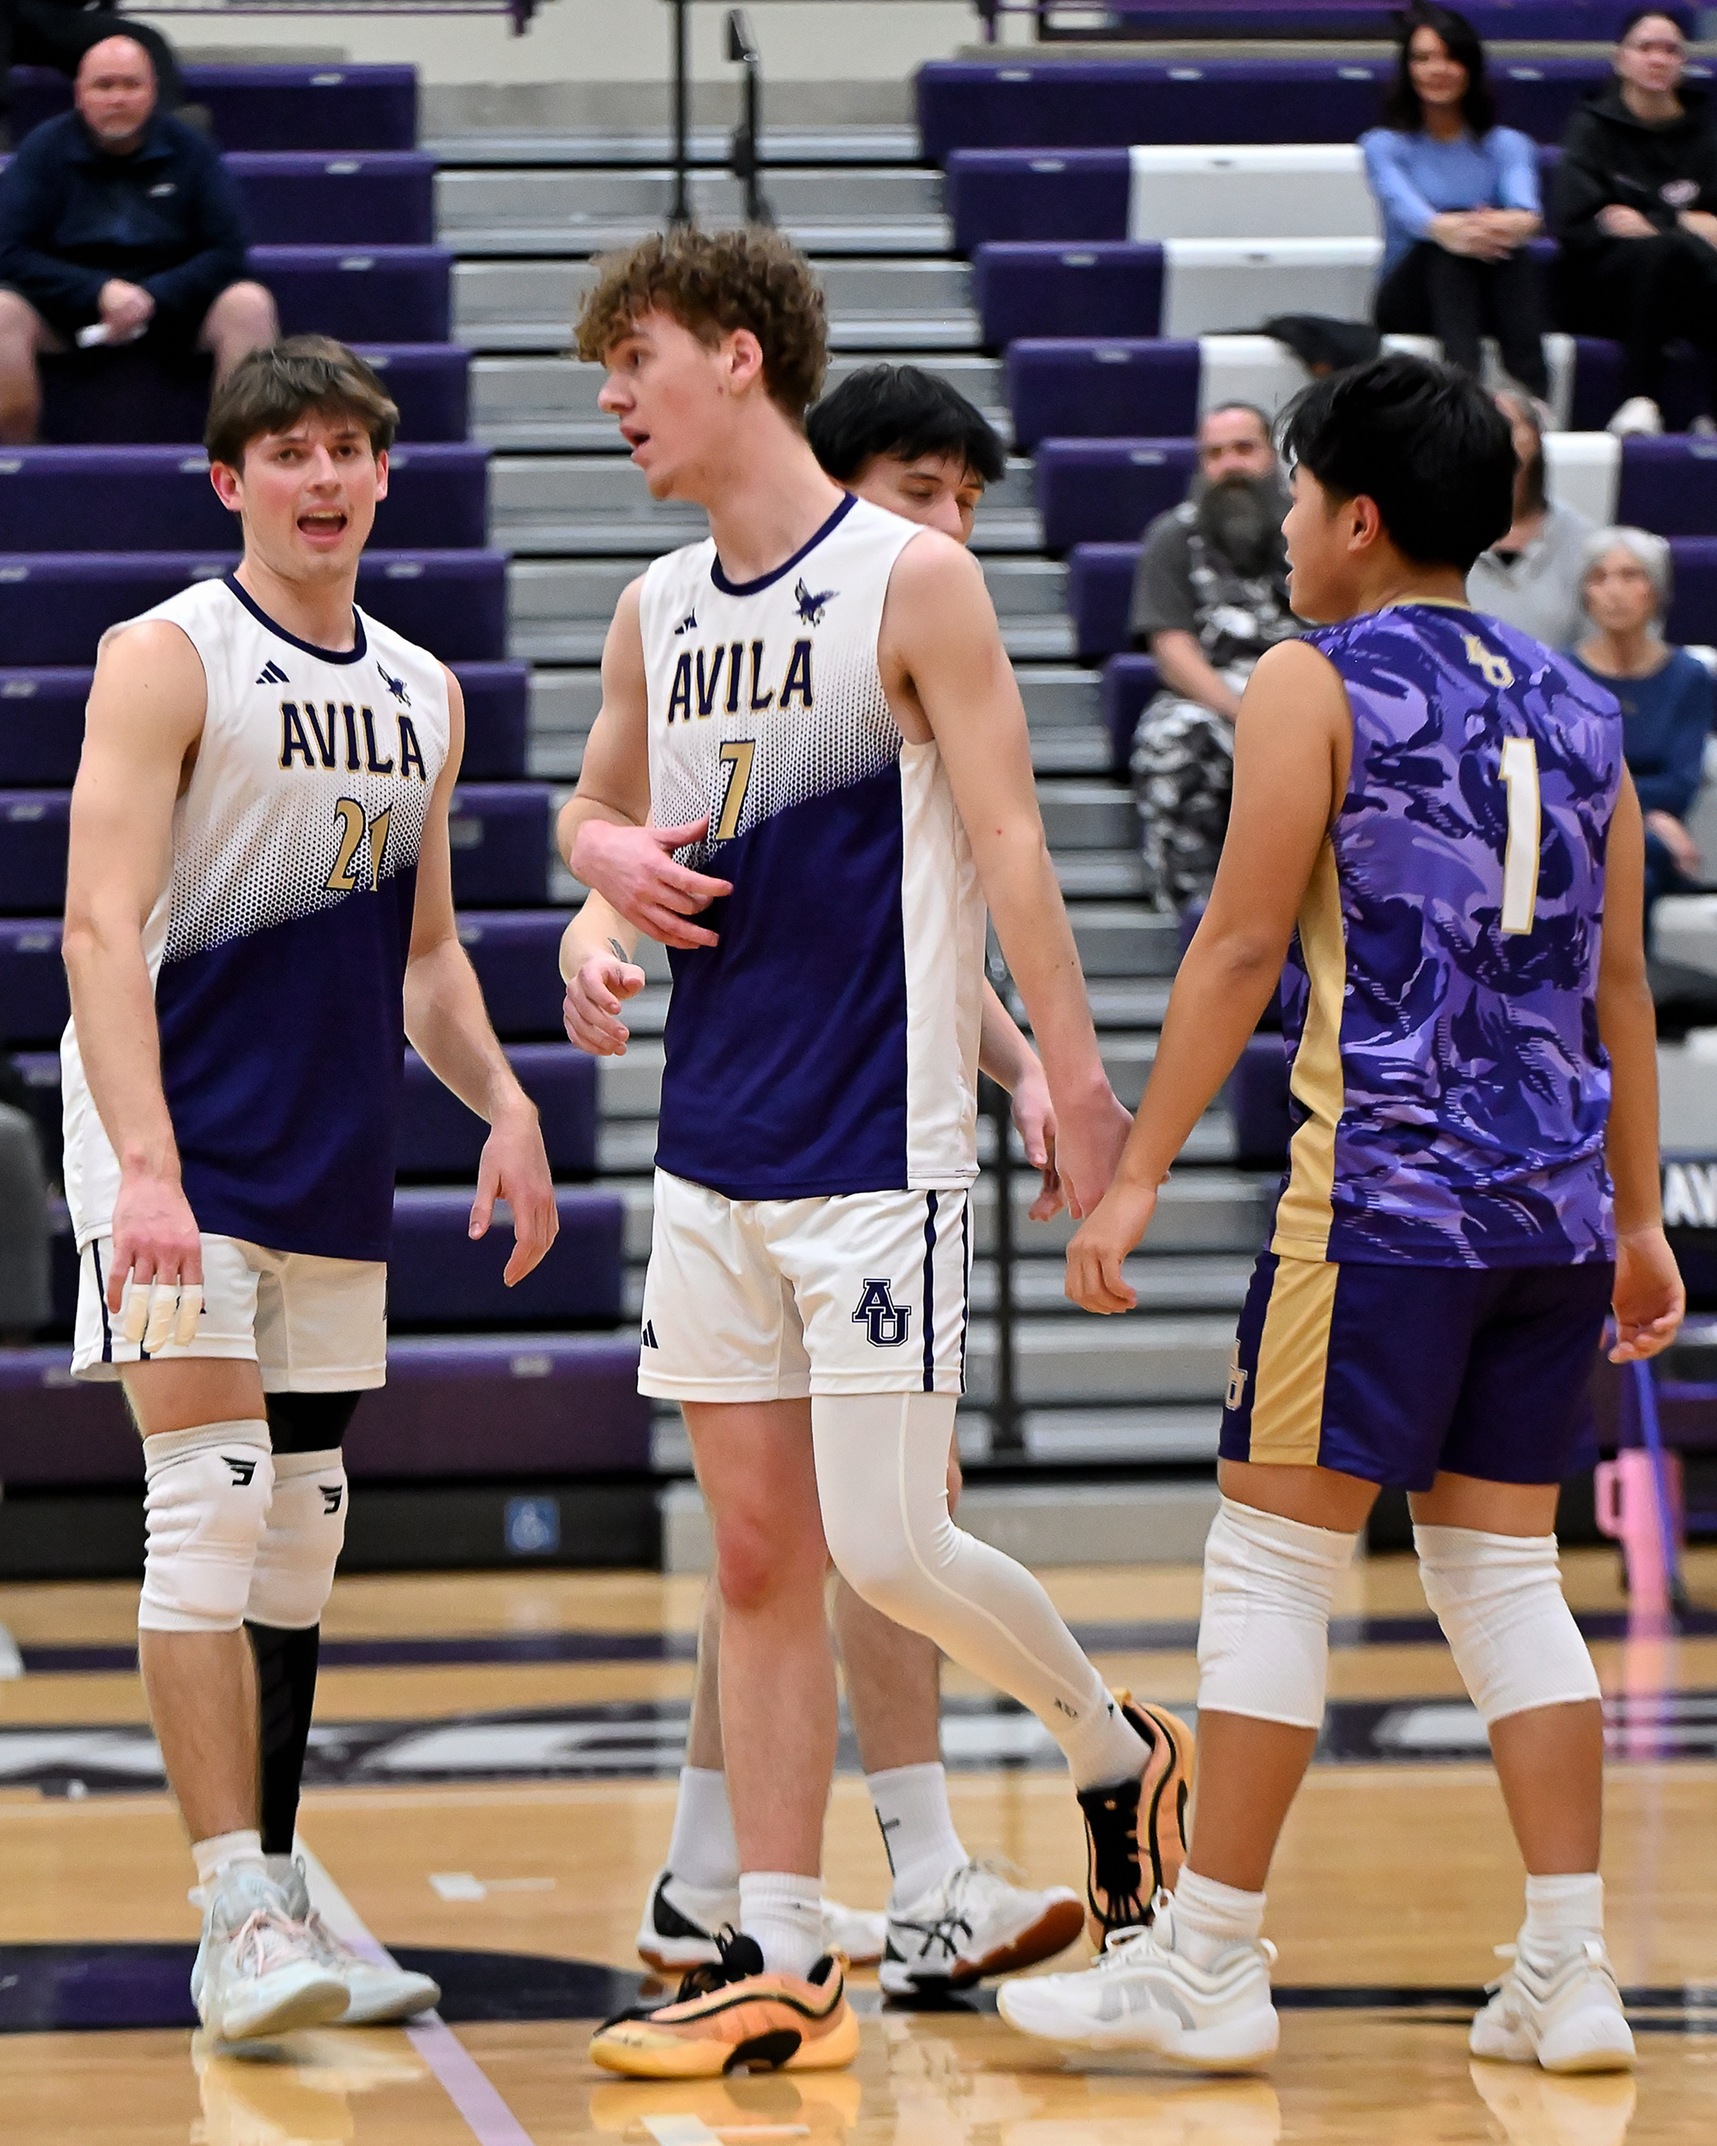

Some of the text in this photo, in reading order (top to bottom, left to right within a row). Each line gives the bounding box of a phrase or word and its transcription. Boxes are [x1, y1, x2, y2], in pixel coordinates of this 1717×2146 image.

[666, 639, 815, 728] AVILA
[278, 700, 427, 785] AVILA
[715, 738, 757, 841] 7
[1498, 737, 1542, 935] 1
[324, 796, 395, 893] 21
[851, 1277, 912, 1348] AU
